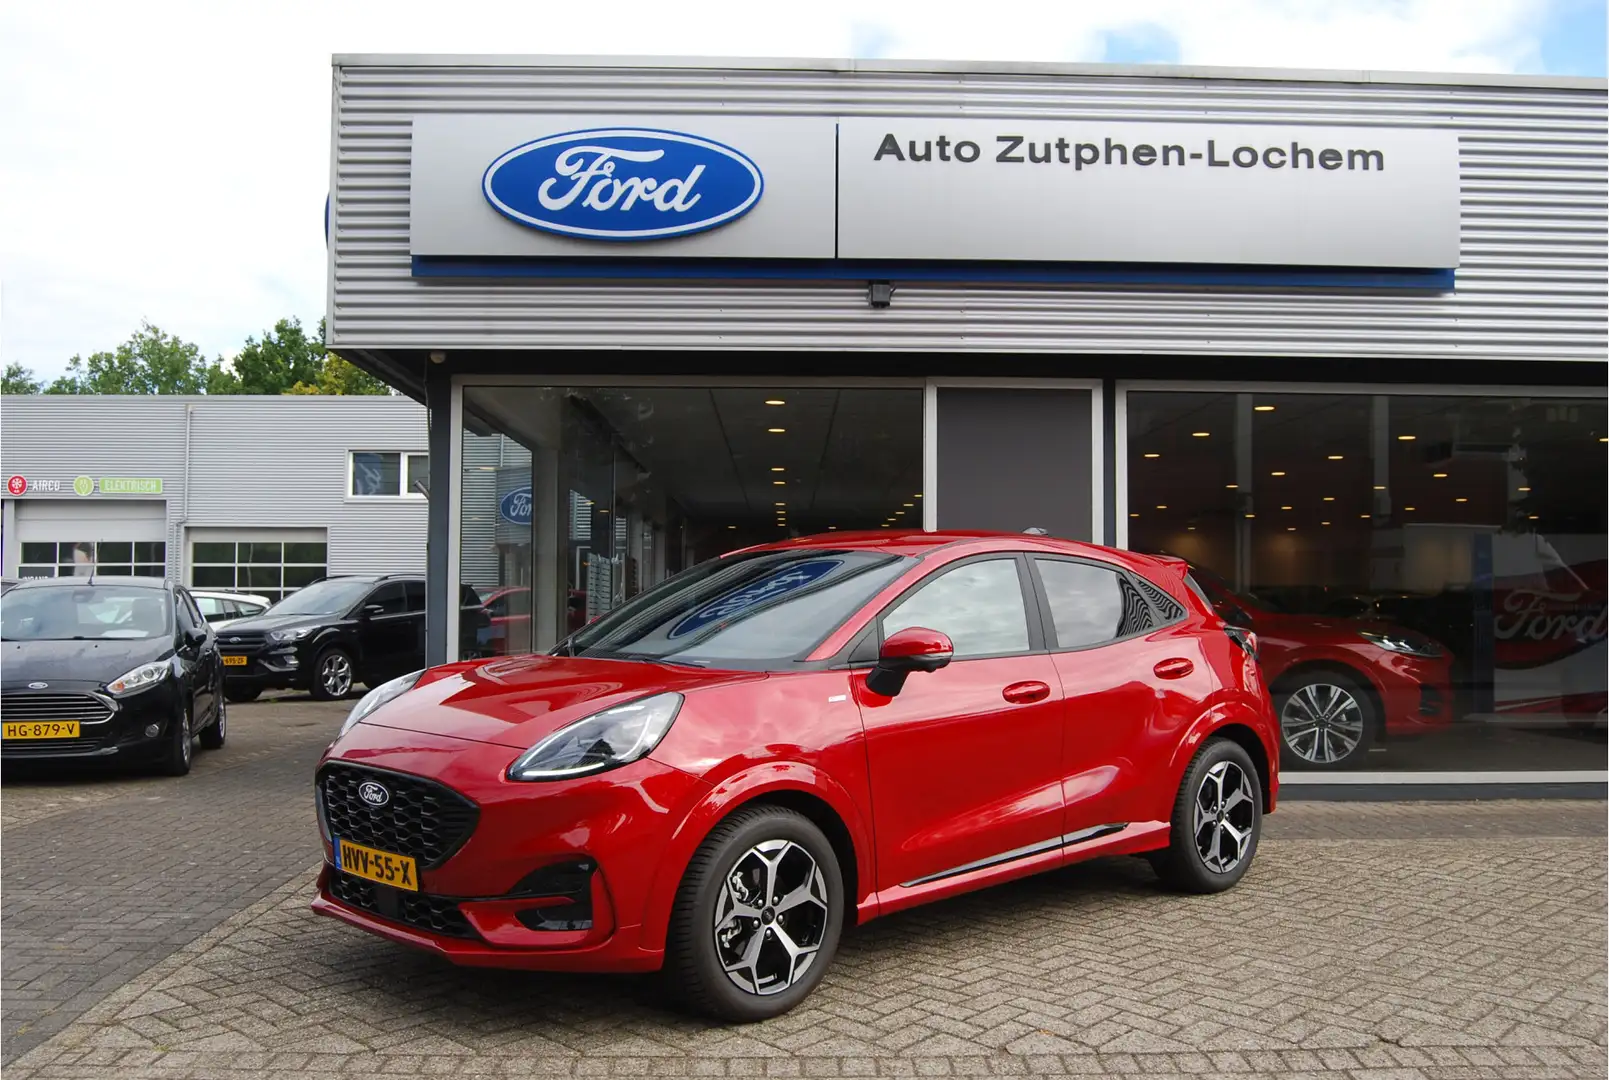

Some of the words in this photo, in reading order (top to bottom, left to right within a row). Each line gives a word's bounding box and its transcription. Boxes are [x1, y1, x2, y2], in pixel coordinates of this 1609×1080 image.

[874, 133, 981, 163] Auto
[995, 135, 1384, 171] Zutphen-Lochem
[538, 145, 706, 212] Ford
[32, 480, 61, 491] AIRCO
[104, 478, 157, 491] ELEKTRISCH
[8, 723, 75, 737] HG-879-V
[363, 784, 383, 802] Ford
[342, 844, 412, 886] HVV-55-X
